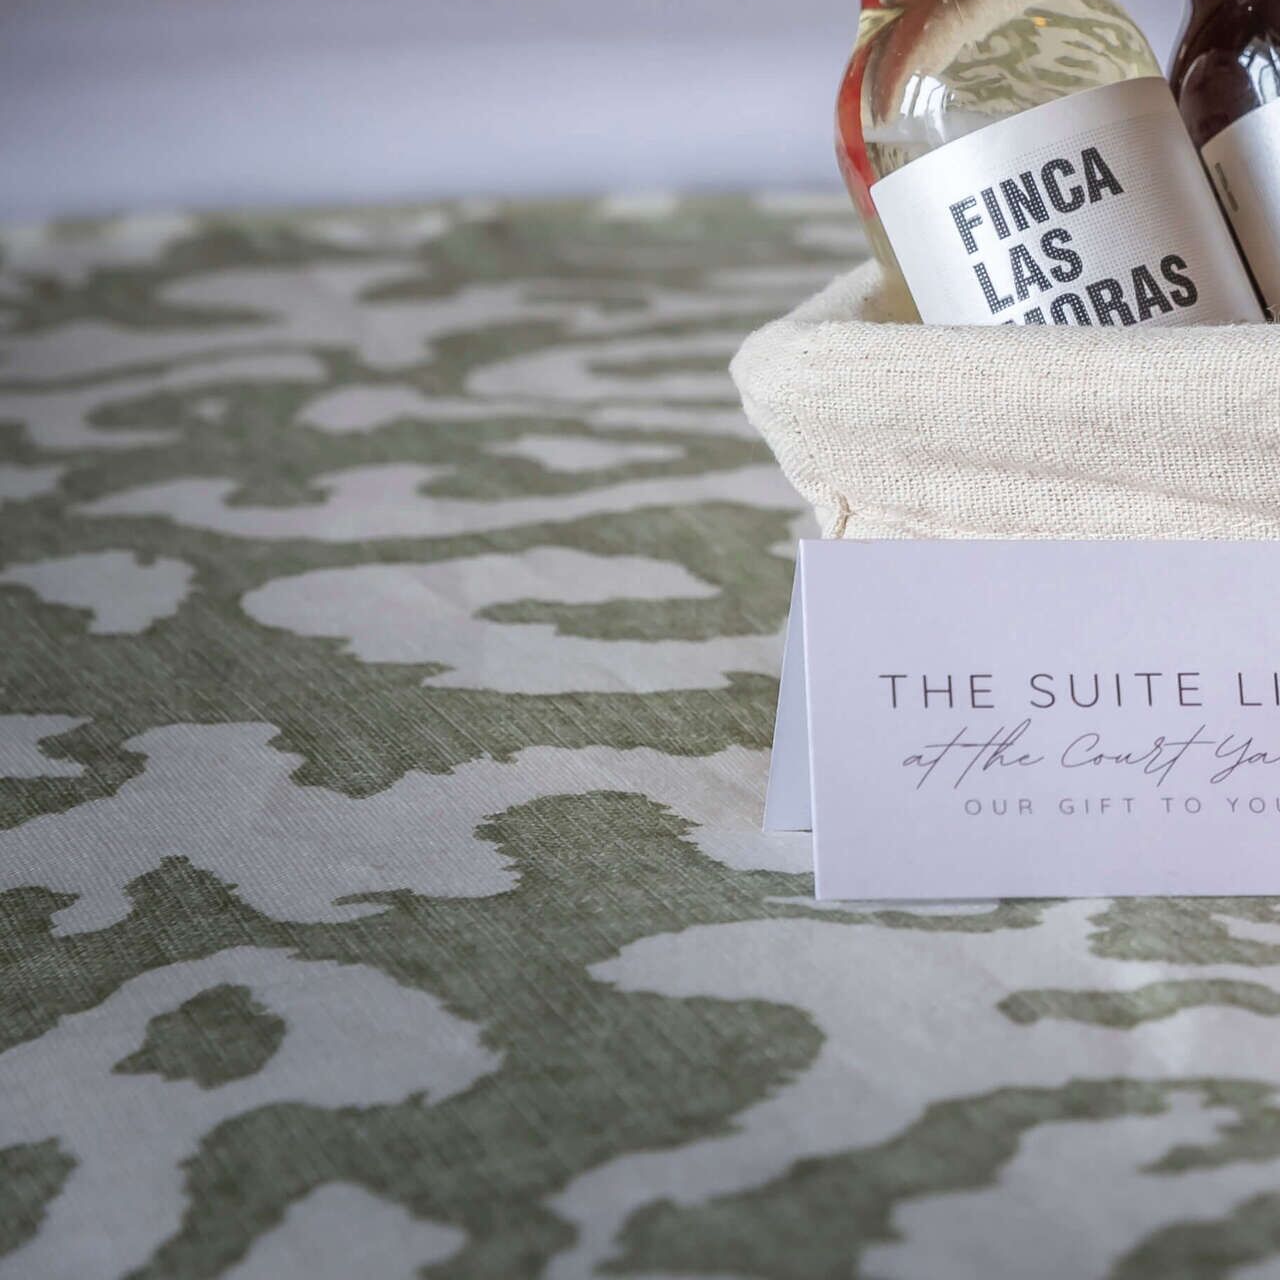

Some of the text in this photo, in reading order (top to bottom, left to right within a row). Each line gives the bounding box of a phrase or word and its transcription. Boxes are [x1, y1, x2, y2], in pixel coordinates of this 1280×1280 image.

[949, 146, 1125, 255] FINCA
[972, 227, 1084, 315] LAS
[879, 673, 996, 710] THE
[1030, 672, 1204, 709] SUITE
[902, 725, 967, 790] at
[954, 718, 1044, 790] the
[1060, 724, 1217, 788] Court
[964, 797, 1034, 816] OUR
[1058, 797, 1137, 815] GIFT
[1160, 796, 1202, 815] TO
